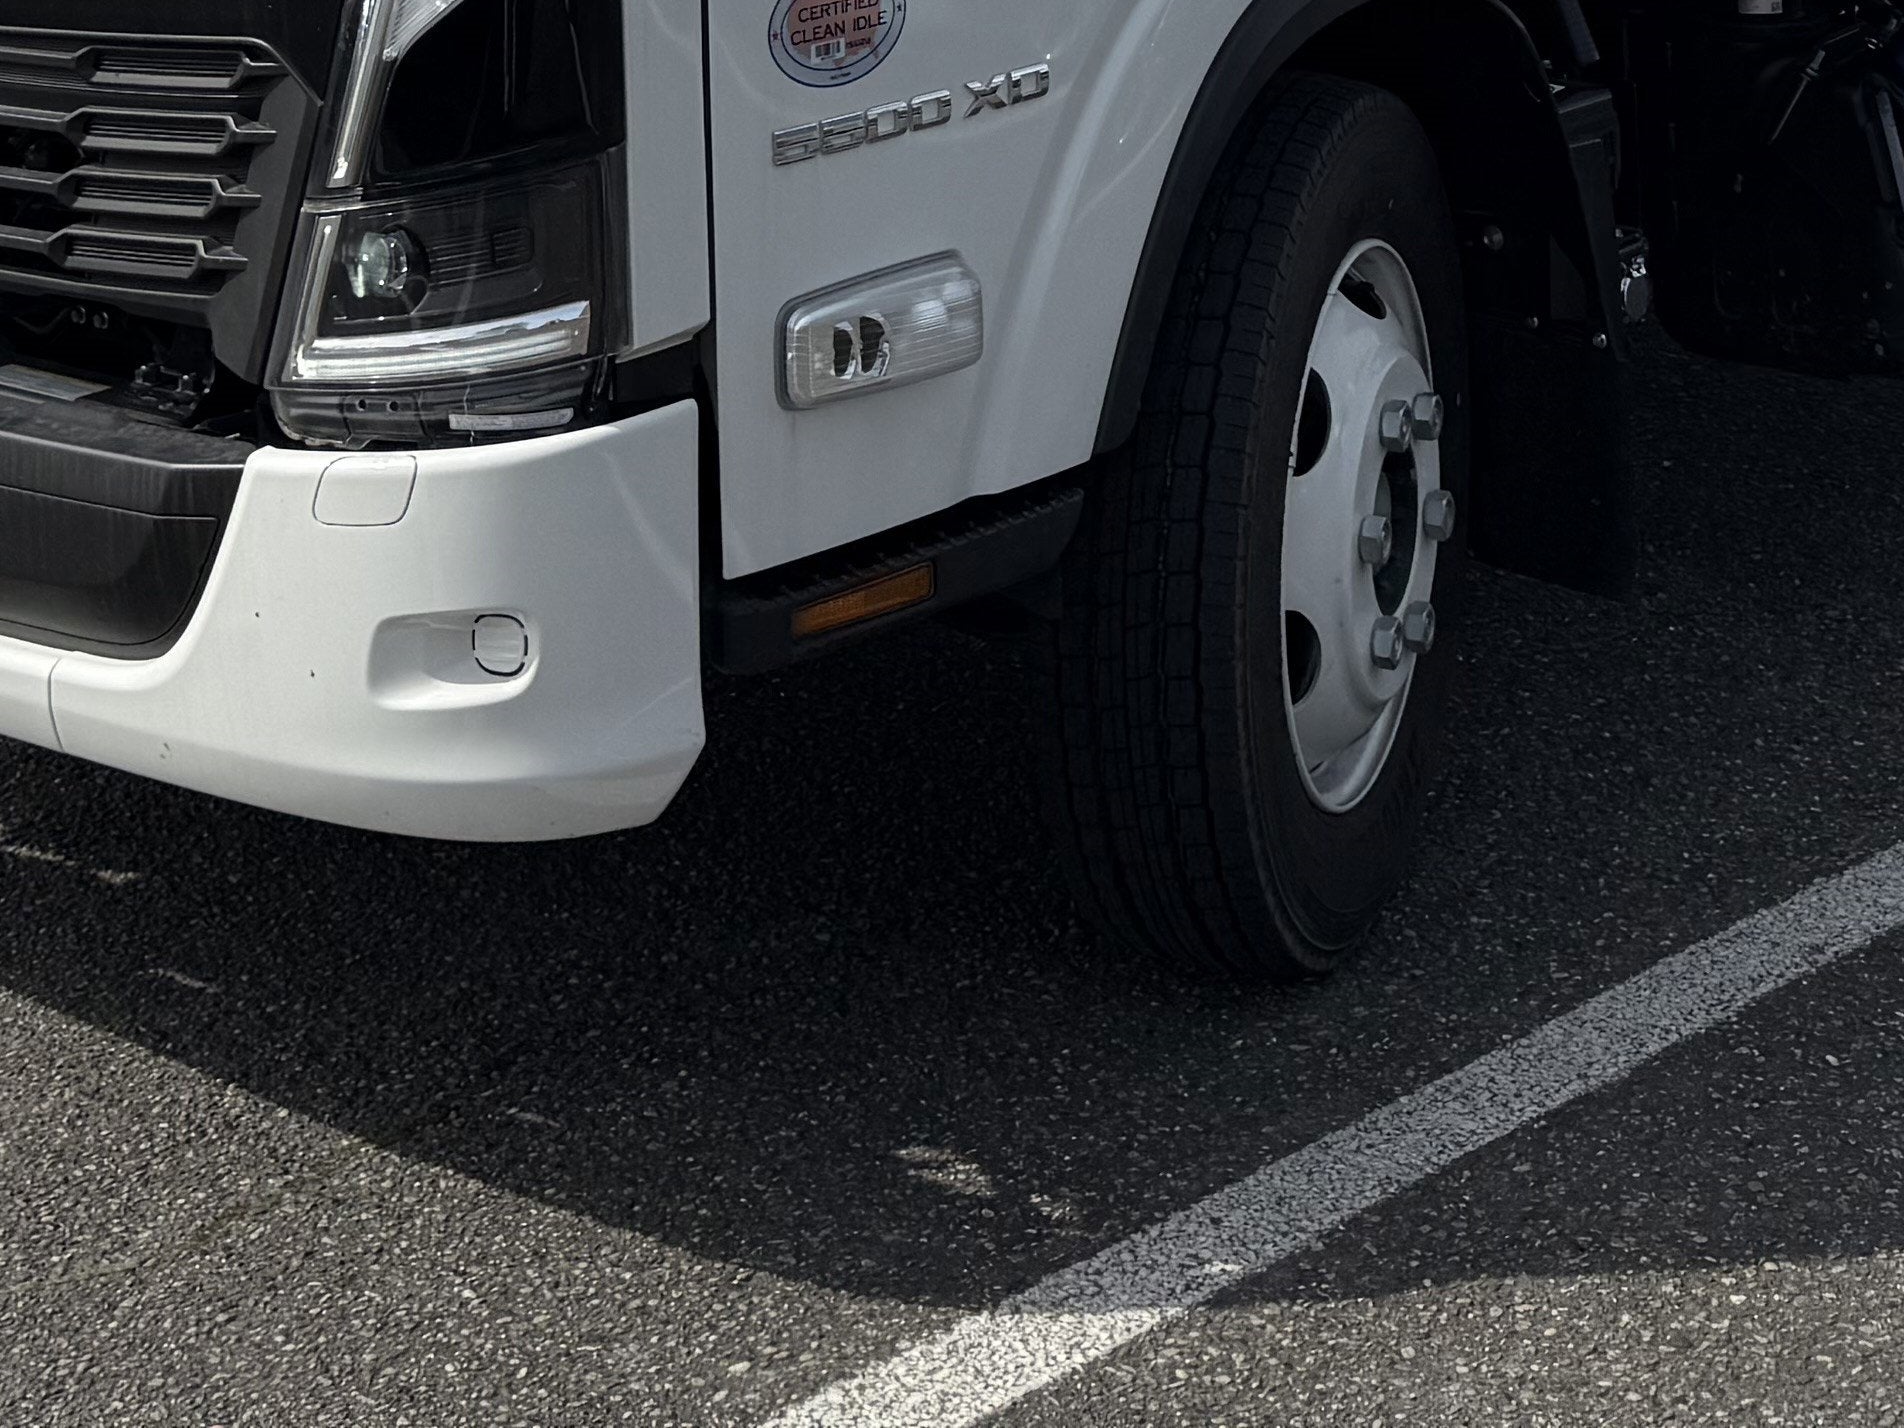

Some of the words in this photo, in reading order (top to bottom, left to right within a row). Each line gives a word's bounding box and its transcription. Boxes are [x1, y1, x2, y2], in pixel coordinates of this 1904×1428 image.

[790, 20, 846, 46] CLEAN
[852, 10, 888, 33] IDLE
[771, 89, 952, 166] 5500
[962, 63, 1050, 119] XD
